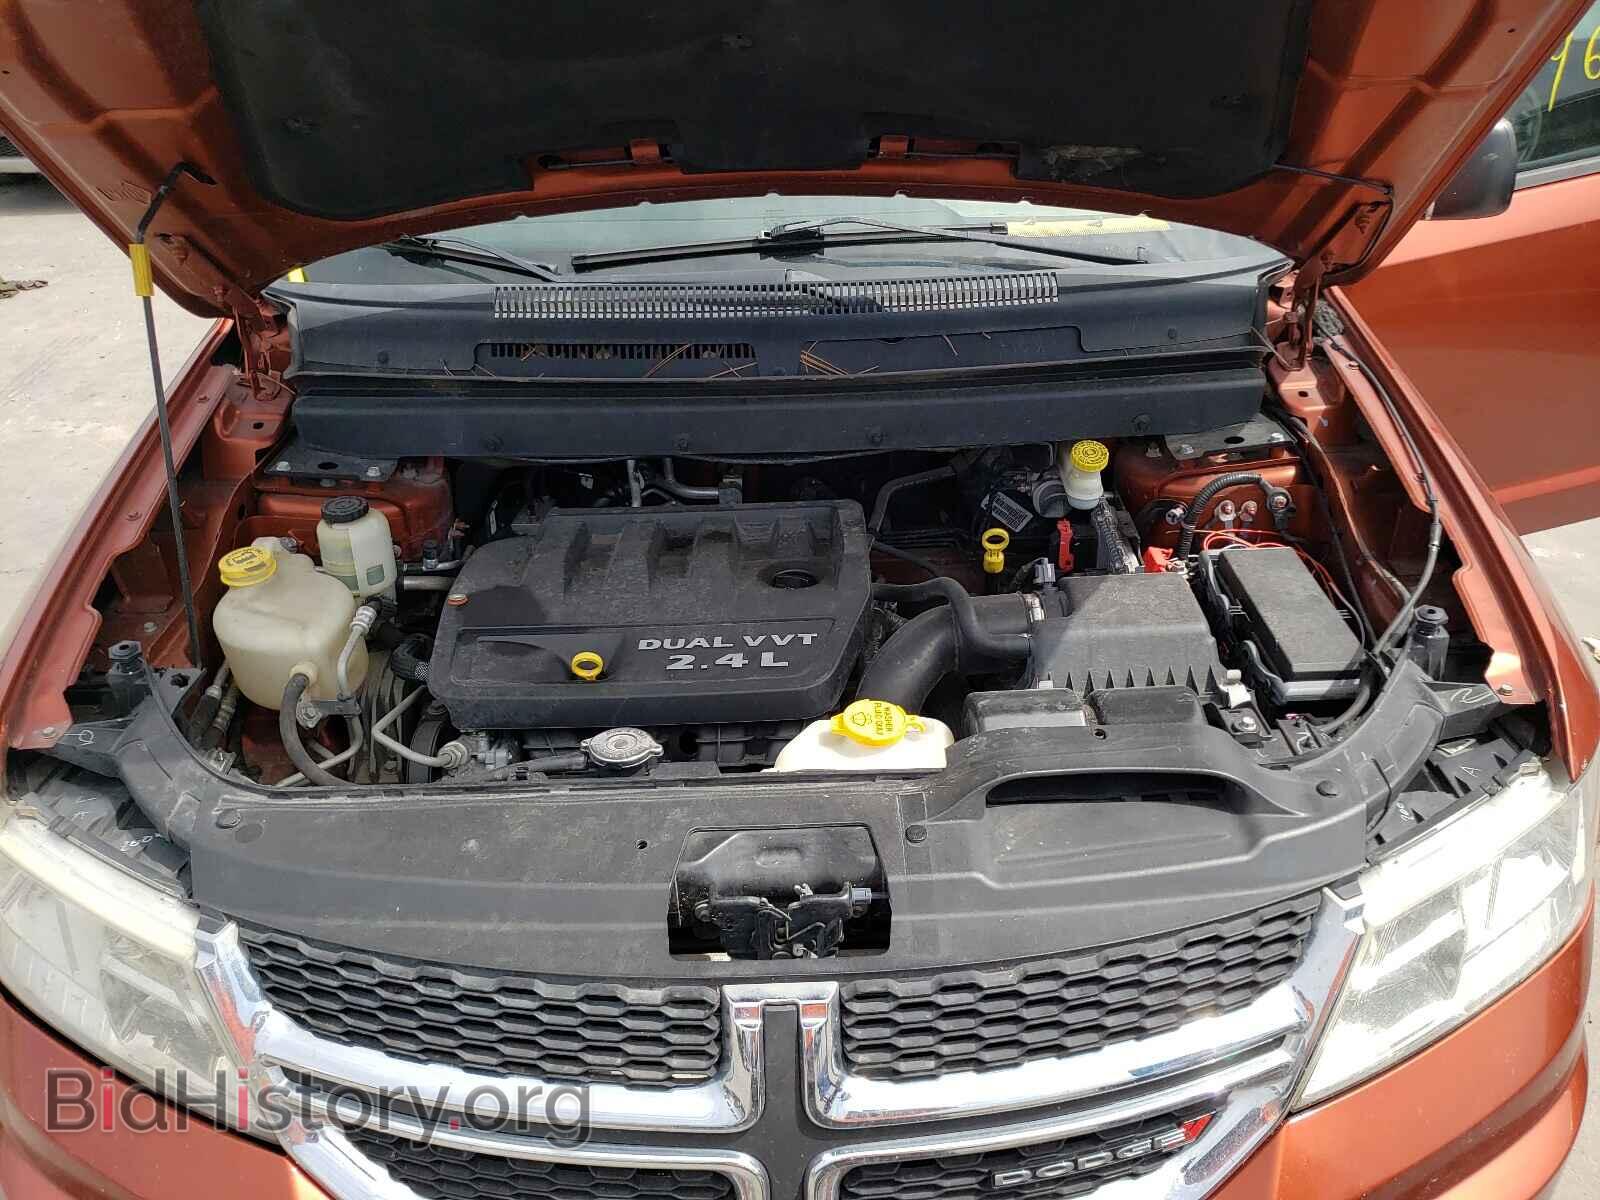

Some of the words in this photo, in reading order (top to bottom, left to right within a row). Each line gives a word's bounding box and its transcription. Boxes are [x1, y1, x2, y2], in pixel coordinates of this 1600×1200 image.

[637, 636, 734, 650] DUAL
[742, 632, 818, 647] VVT
[883, 706, 894, 732] WASHER
[993, 1126, 1188, 1188] DODGE
